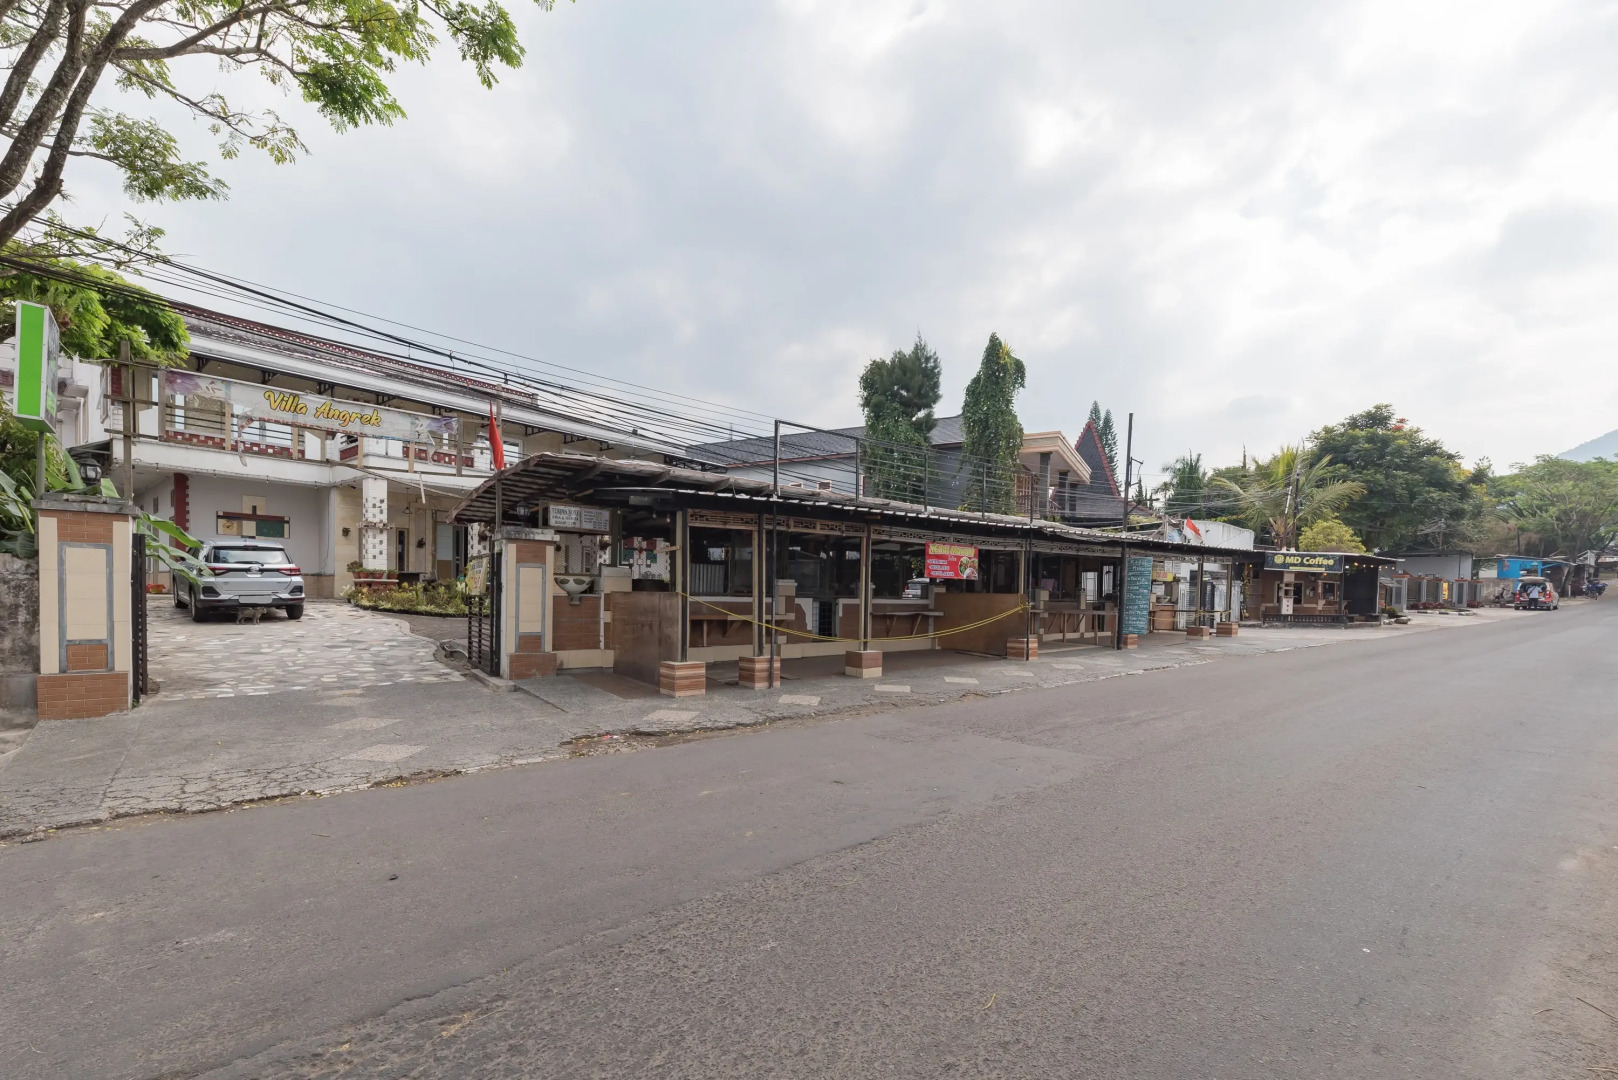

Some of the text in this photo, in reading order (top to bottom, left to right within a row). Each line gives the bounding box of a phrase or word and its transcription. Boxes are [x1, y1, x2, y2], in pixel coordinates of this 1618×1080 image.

[264, 390, 308, 416] Villa
[314, 400, 382, 427] Angrek
[1285, 556, 1334, 566] MD Coffee
